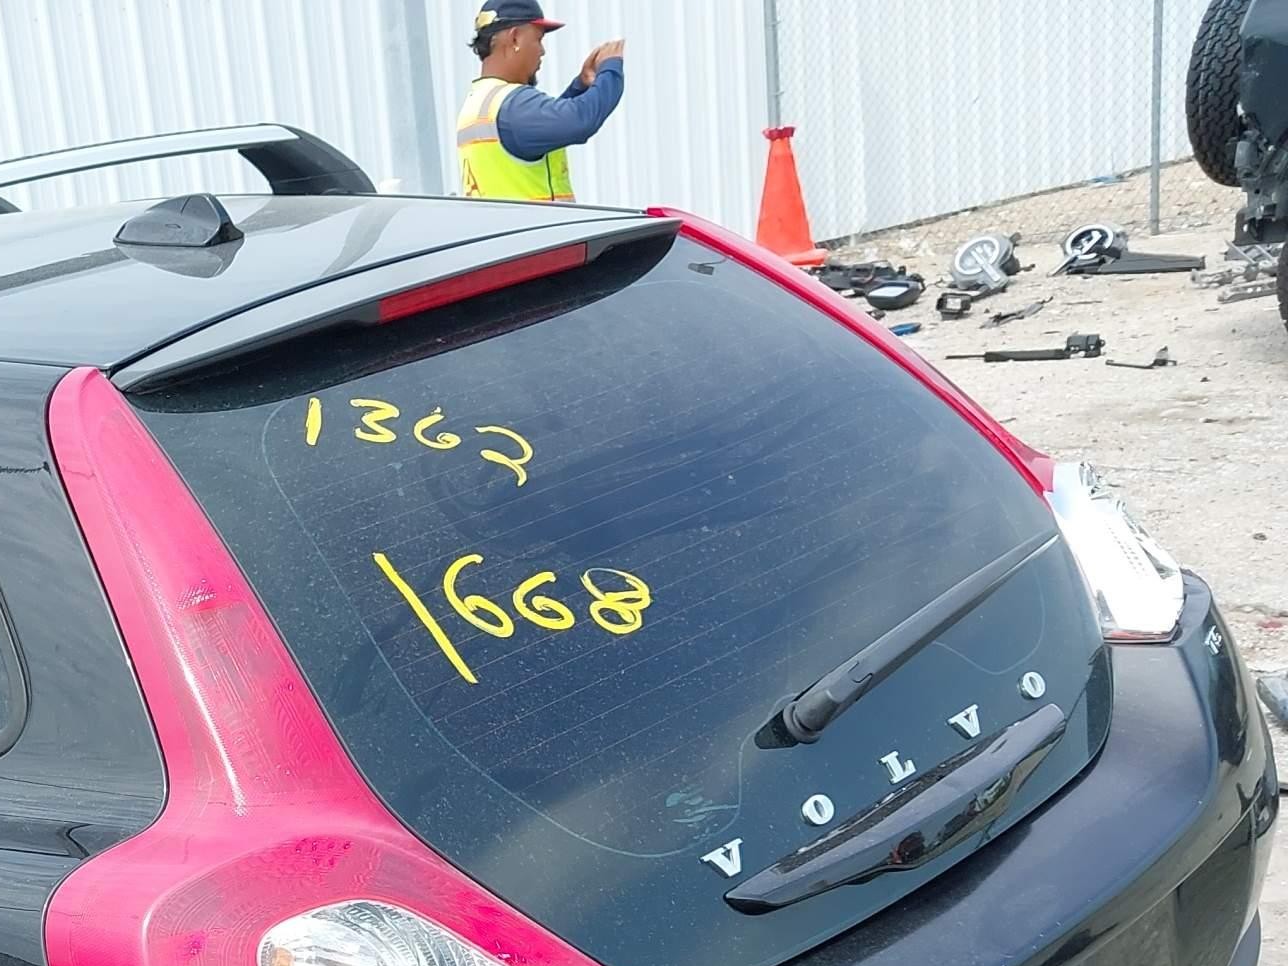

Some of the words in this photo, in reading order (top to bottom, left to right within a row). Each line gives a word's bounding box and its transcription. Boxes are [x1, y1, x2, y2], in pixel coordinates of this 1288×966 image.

[305, 397, 533, 486] 1362
[372, 552, 652, 684] 1668
[698, 671, 1047, 879] VOLVO
